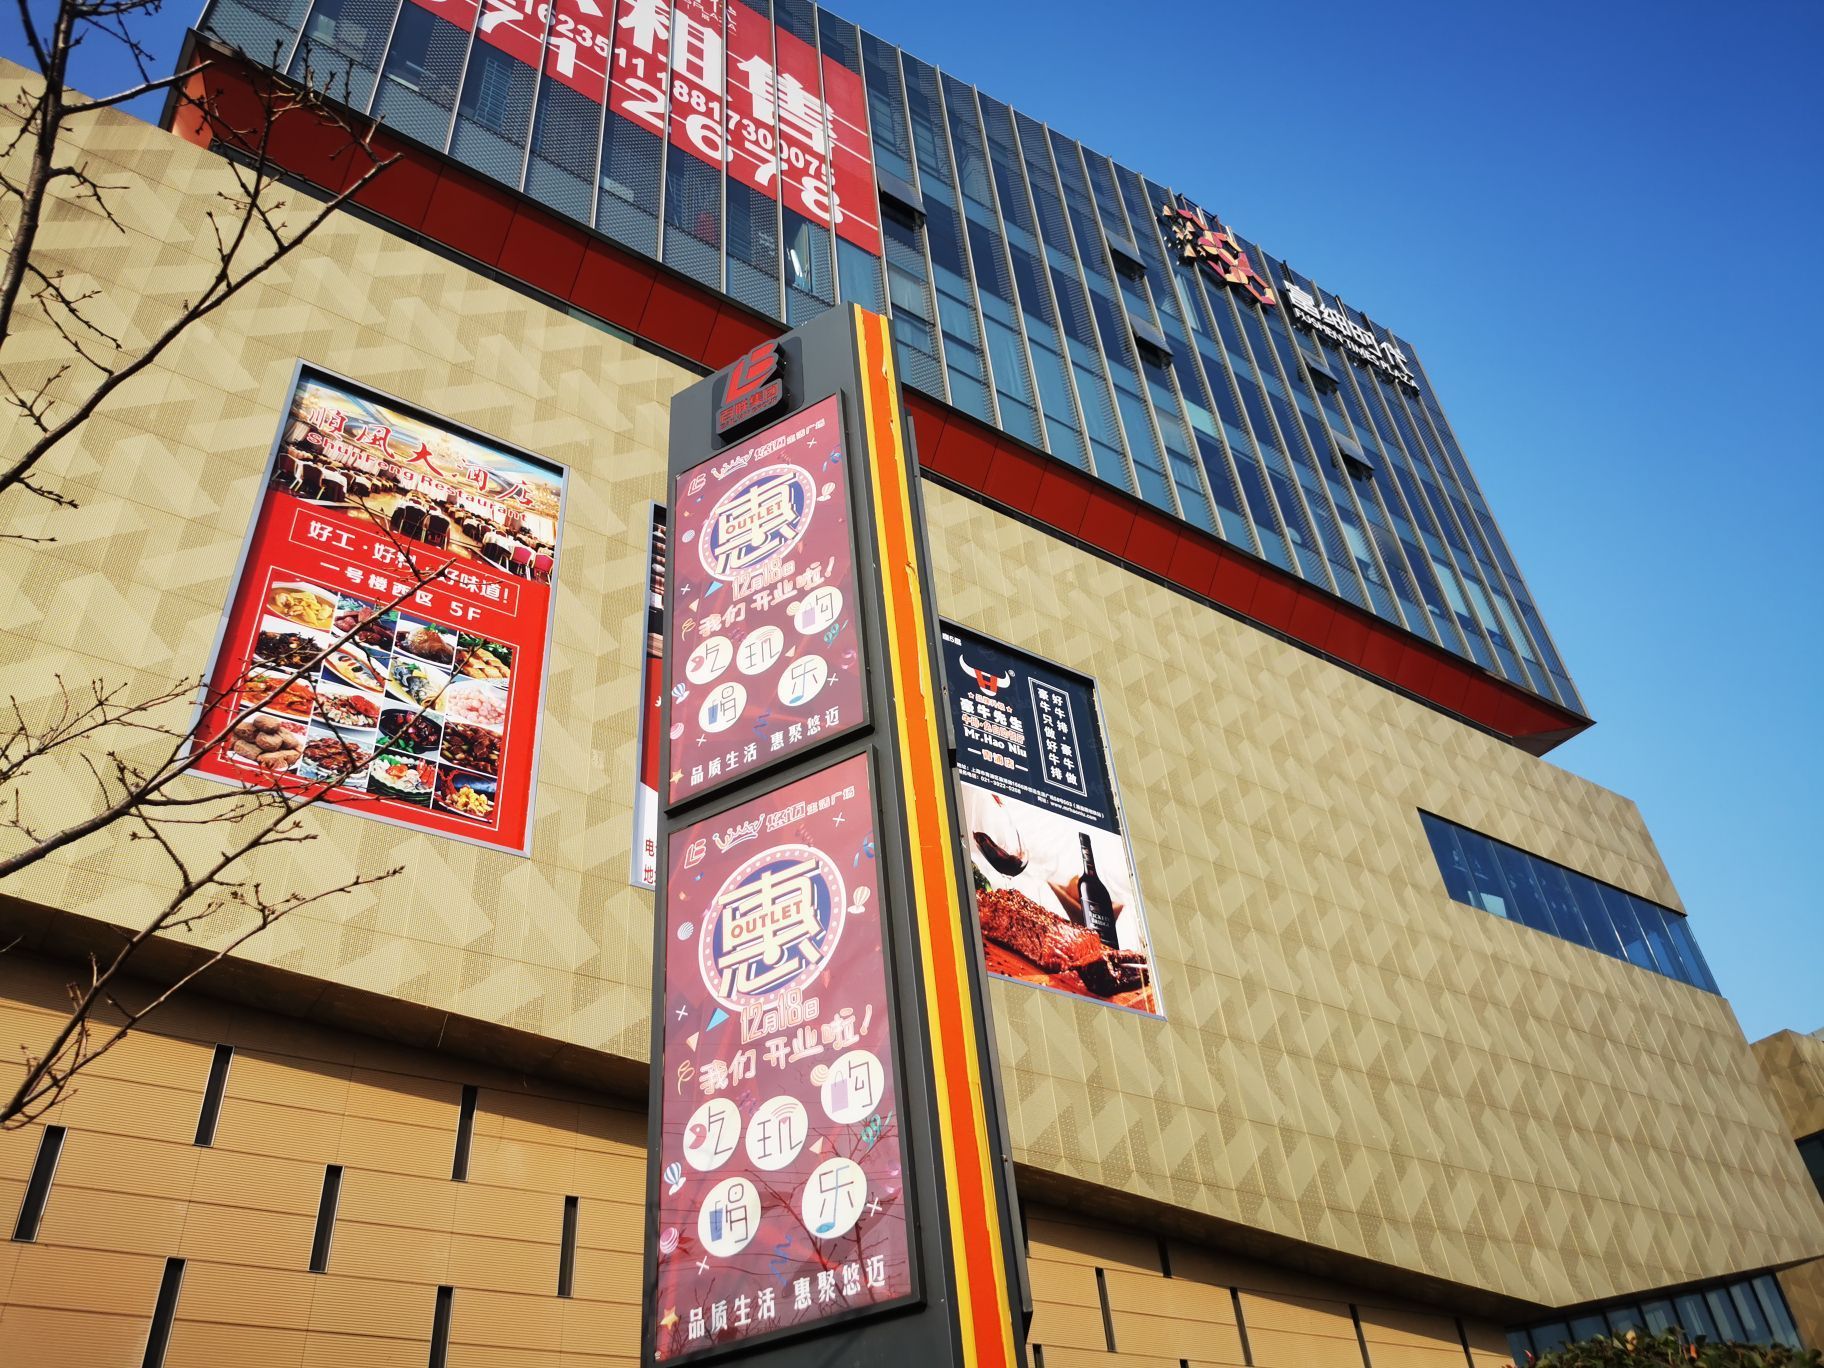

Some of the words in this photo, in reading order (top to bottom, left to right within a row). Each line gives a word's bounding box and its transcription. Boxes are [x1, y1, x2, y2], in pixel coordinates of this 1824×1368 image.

[500, 0, 645, 79] 1623511
[657, 71, 836, 185] 18817300075
[576, 0, 838, 160] 租售
[430, 0, 844, 224] 712678
[306, 429, 415, 482] ShunFeng
[420, 475, 529, 524] Restaurant
[725, 501, 783, 534] OUTLET
[319, 560, 434, 608] 一号楼西区
[449, 600, 482, 621] 5F
[699, 602, 746, 638] 我们
[690, 742, 757, 787] 品质生活
[769, 706, 840, 752] 惠聚悠迈
[963, 726, 1006, 749] Mr.Hao
[730, 902, 803, 939] OUTLET
[740, 985, 820, 1045] 12月18日
[698, 1048, 757, 1096] 我们
[688, 1286, 776, 1341] 品质生活
[793, 1253, 887, 1311] 惠聚悠迈
